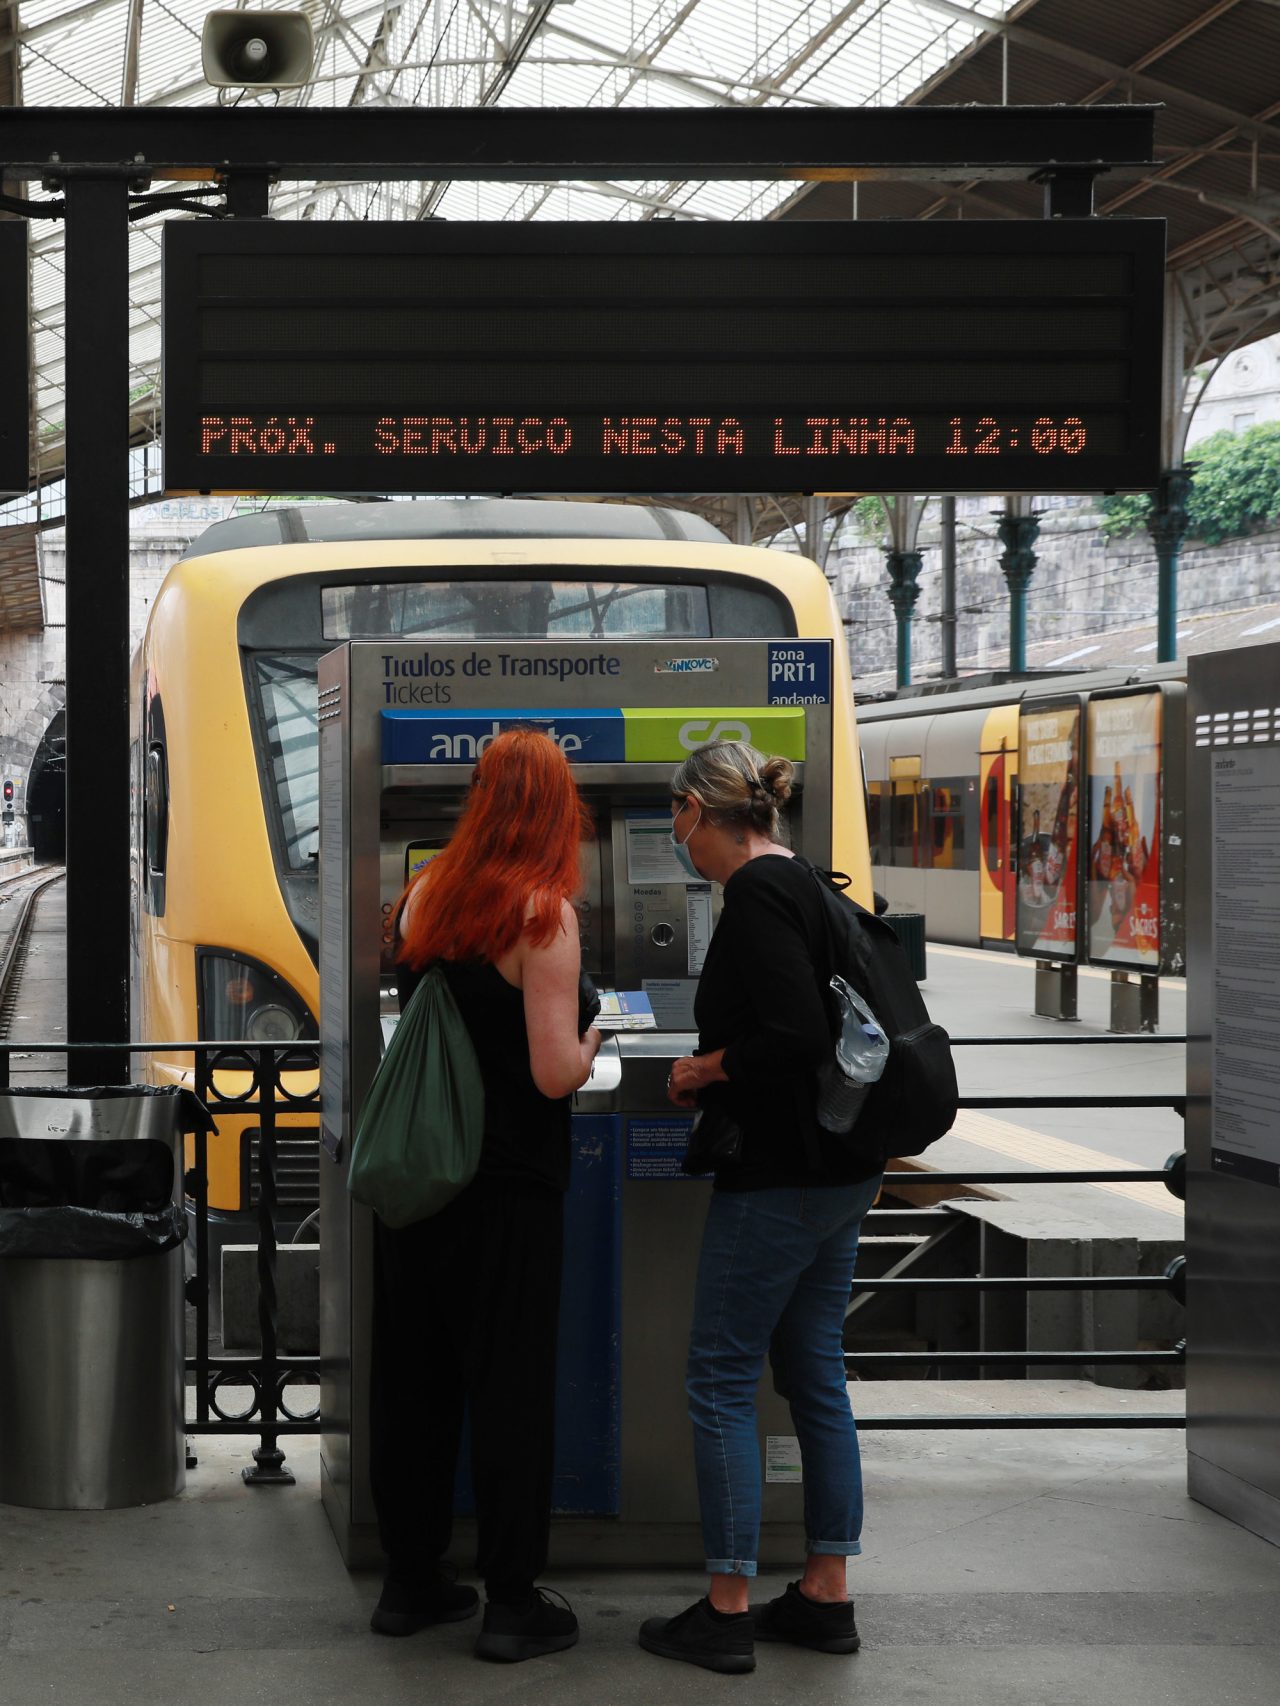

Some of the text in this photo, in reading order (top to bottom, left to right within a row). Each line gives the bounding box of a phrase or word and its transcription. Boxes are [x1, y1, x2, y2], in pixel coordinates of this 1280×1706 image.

[604, 418, 743, 454] NESTA
[775, 418, 915, 454] LINHA
[946, 418, 1085, 453] 12:00
[772, 650, 804, 661] zona
[463, 653, 491, 677] de
[499, 653, 620, 681] Transporte
[772, 663, 816, 682] PRT1
[382, 681, 451, 704] Tickets
[772, 693, 826, 704] andante
[634, 888, 662, 896] Moedas
[1129, 915, 1158, 938] SAGRES
